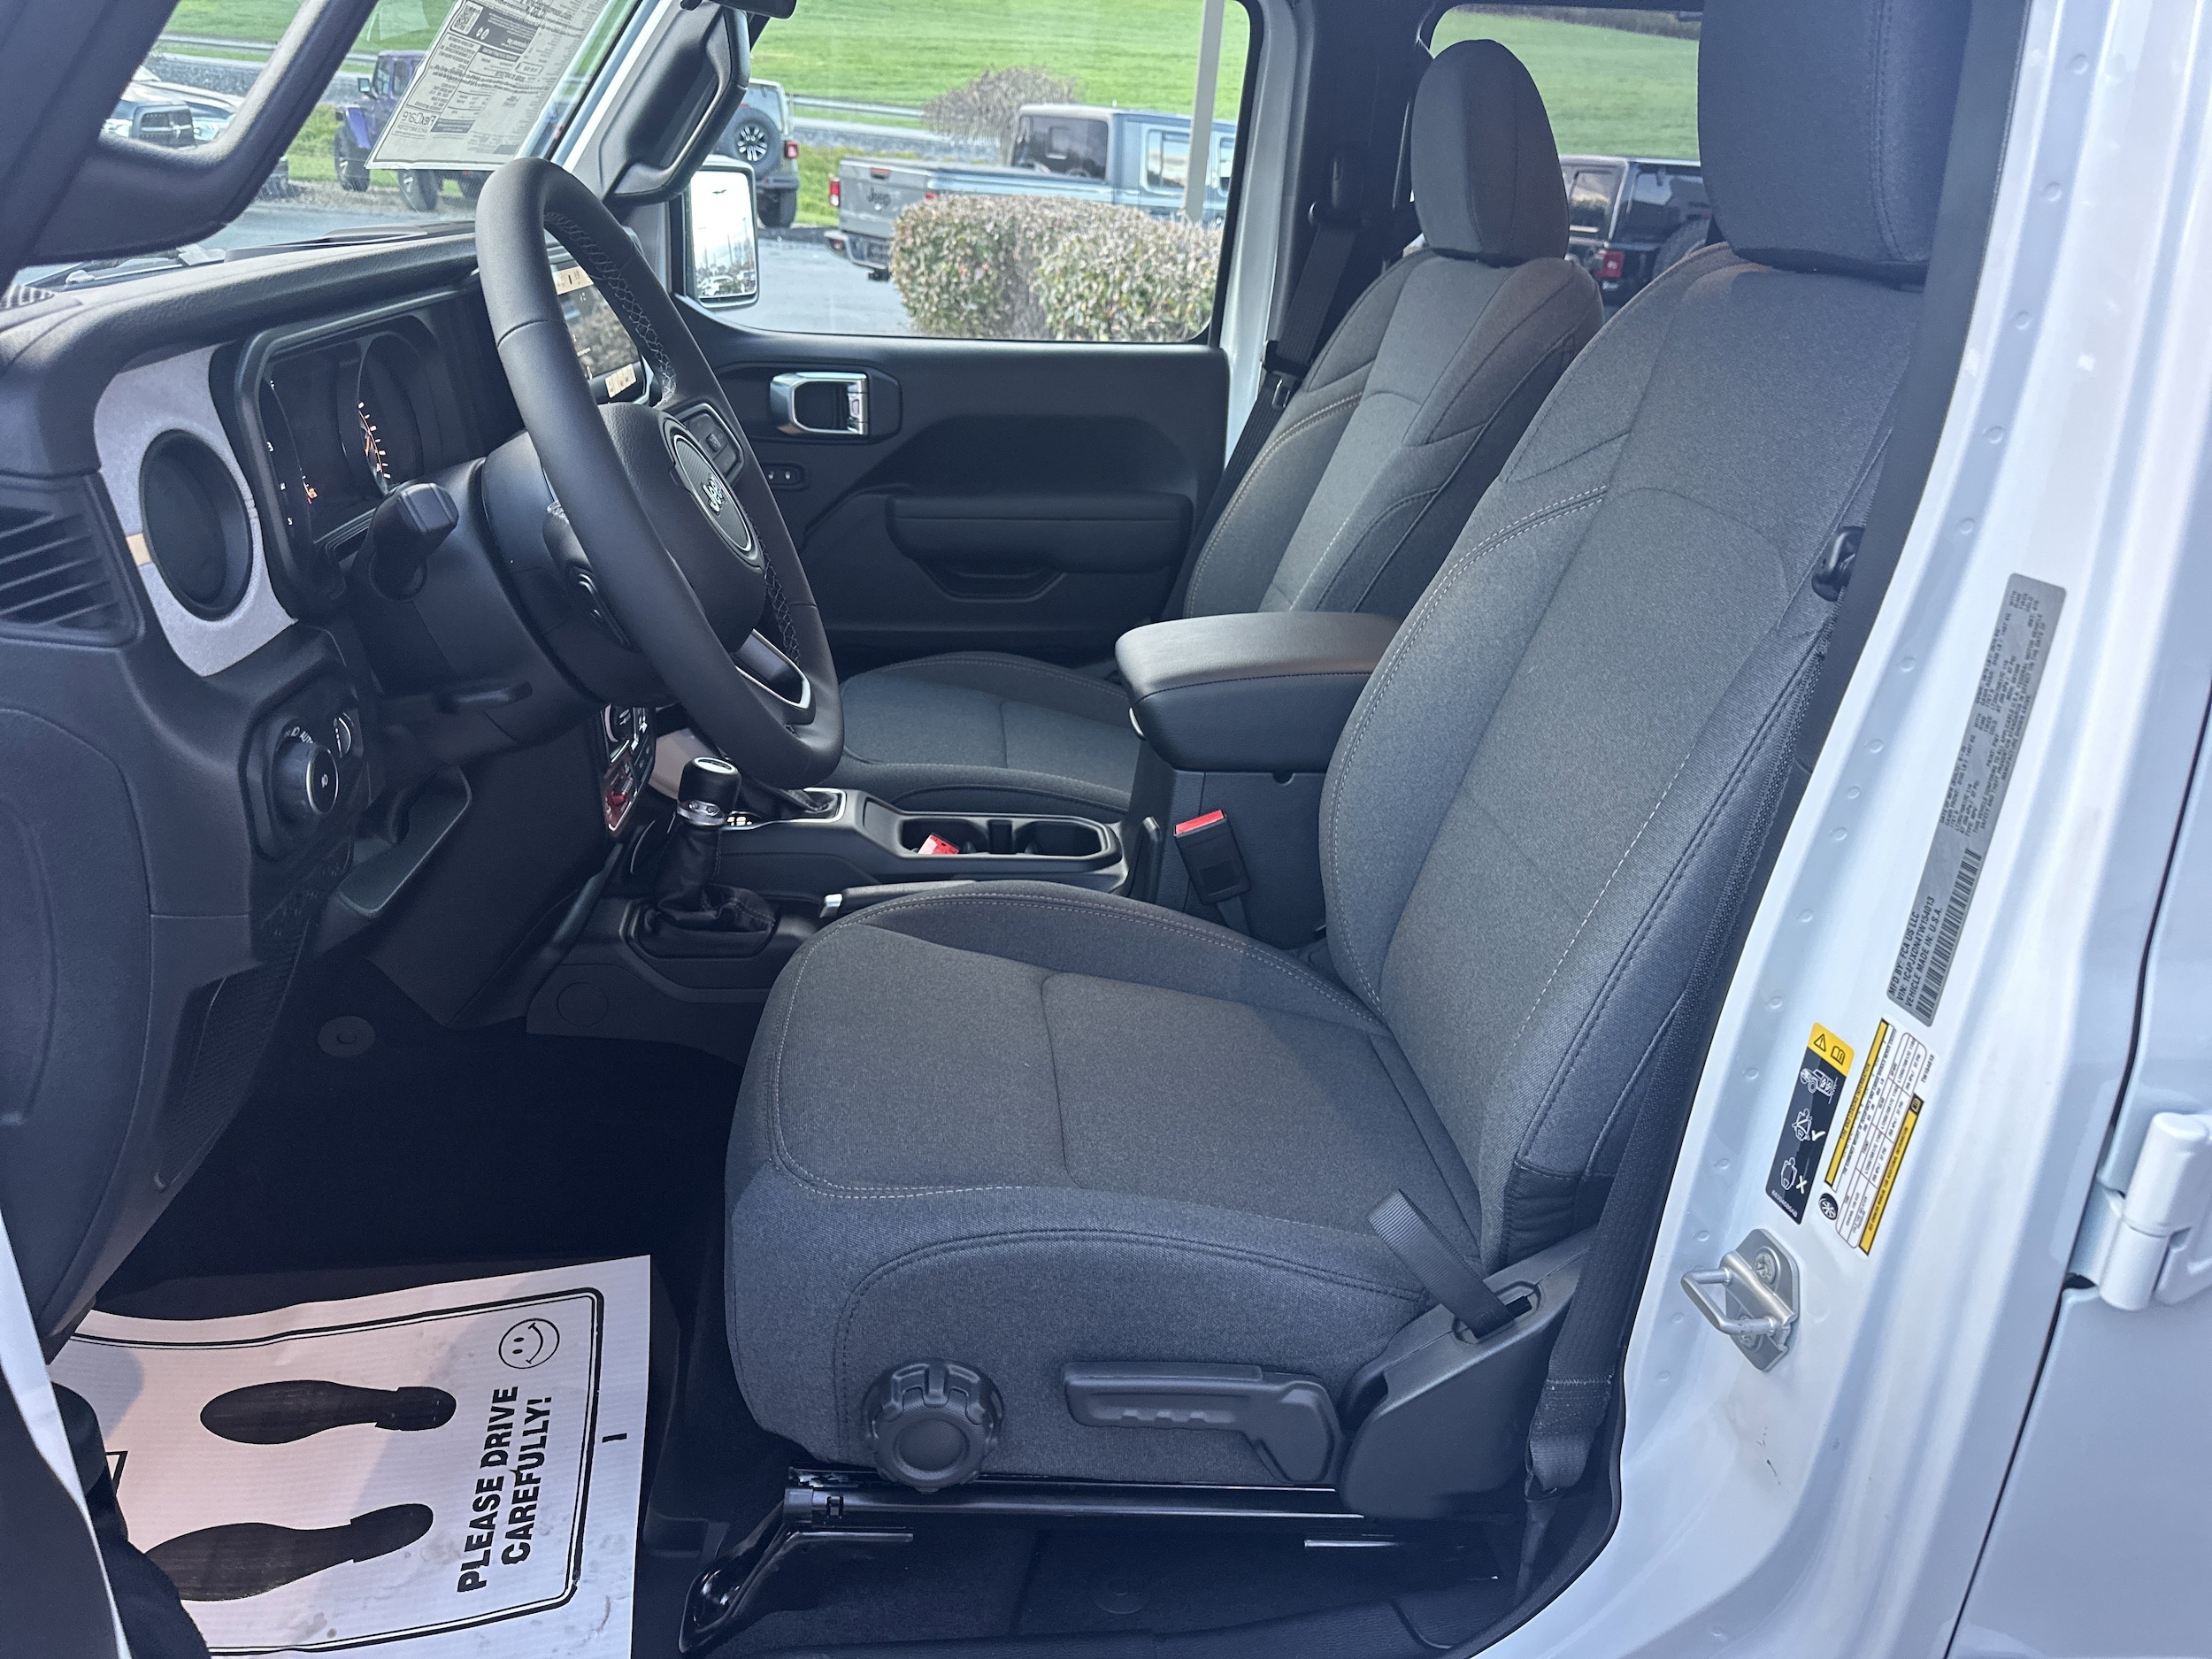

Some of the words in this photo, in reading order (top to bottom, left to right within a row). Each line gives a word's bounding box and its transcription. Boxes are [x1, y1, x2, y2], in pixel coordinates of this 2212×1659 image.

[867, 188, 892, 207] Jeep
[1909, 910, 1919, 927] LLC
[1906, 927, 1914, 941] US
[1901, 941, 1909, 959] FCA
[1906, 972, 1921, 1008] VEHICLE
[1916, 947, 1929, 972] MADE
[1924, 933, 1933, 947] IN:
[1929, 903, 1942, 933] U.S.A.
[1895, 959, 1904, 976] BY:
[1889, 975, 1899, 996] MFD
[1898, 983, 1907, 1002] VIN:
[480, 1386, 518, 1467] DRIVE
[501, 1396, 552, 1565] CAREFULLY!
[457, 1475, 504, 1594] PLEASE
